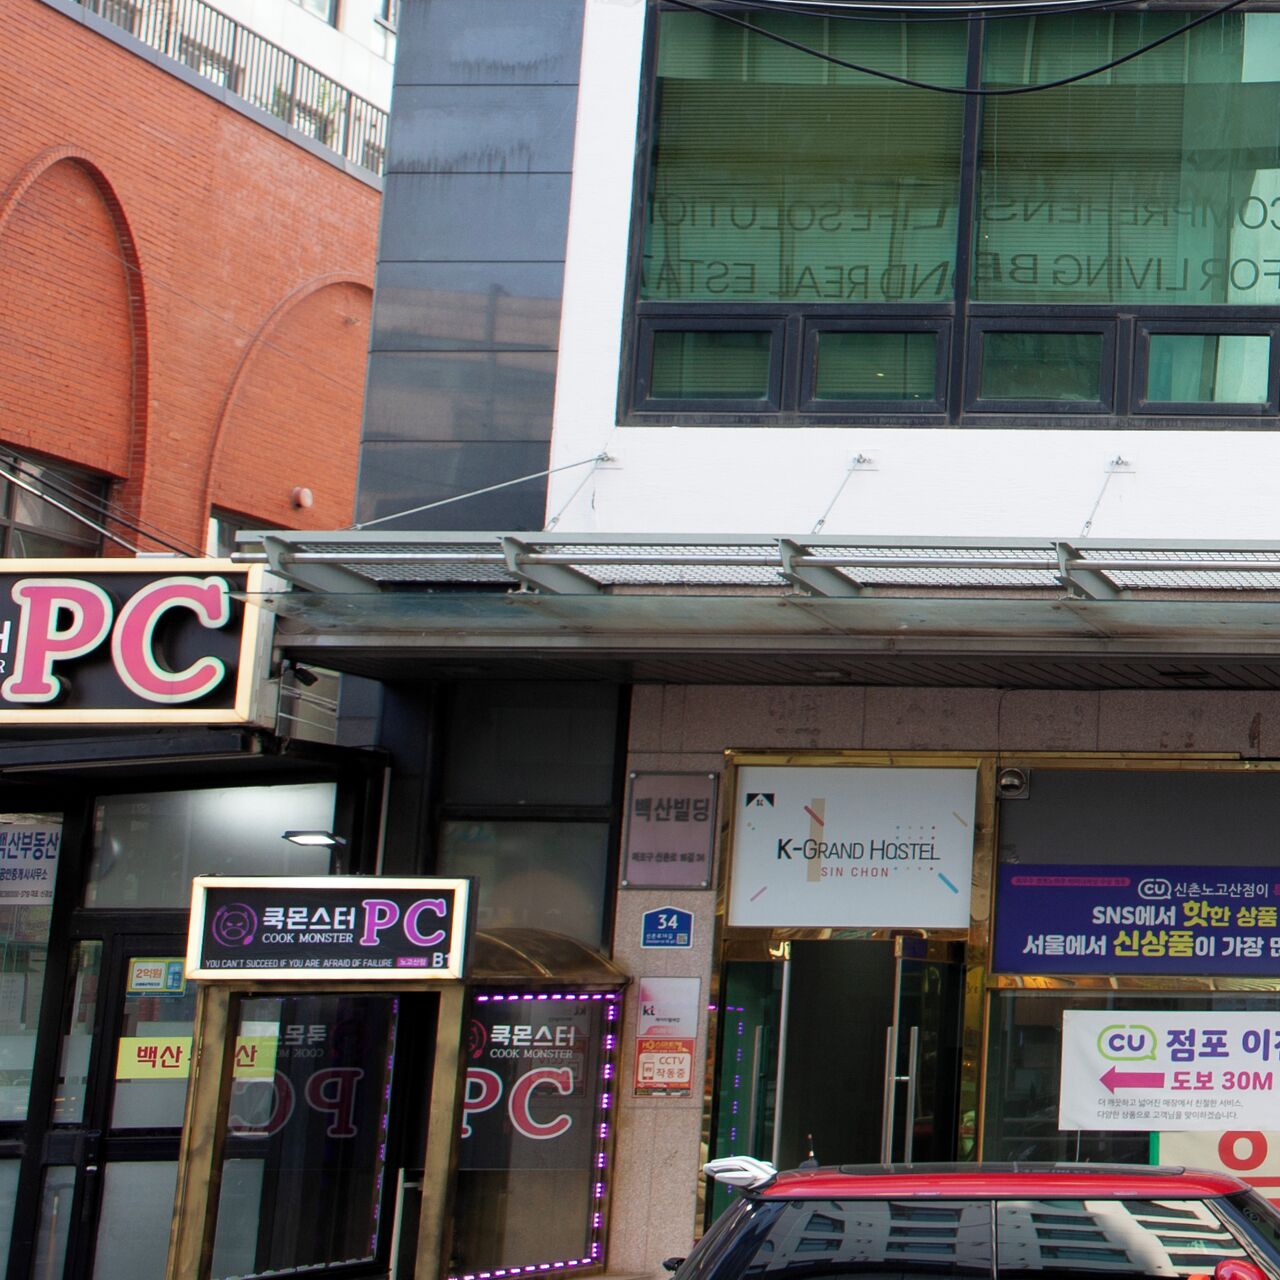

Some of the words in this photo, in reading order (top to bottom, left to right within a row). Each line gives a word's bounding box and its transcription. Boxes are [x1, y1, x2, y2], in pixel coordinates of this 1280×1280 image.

[1, 576, 230, 704] PC
[634, 797, 710, 823] 백산빌딩
[820, 866, 844, 878] SIN
[850, 866, 889, 878] CHON
[1174, 882, 1269, 898] 신촌노고산점이
[262, 906, 356, 930] 쿡몬스터
[360, 898, 447, 947] PC
[657, 913, 679, 930] 34
[1091, 905, 1177, 926] SNS에서
[1182, 900, 1231, 927] 핫한
[1236, 906, 1278, 928] 상품
[261, 932, 295, 944] COOK
[298, 932, 354, 944] MONSTER
[1022, 934, 1107, 956] 서울에서
[1112, 929, 1215, 957] 신상품이
[1221, 936, 1265, 957] 가장
[205, 958, 220, 968] YOU
[289, 958, 302, 968] YOU
[305, 958, 320, 968] ARE
[490, 1024, 576, 1047] 쿡몬스터
[1166, 1028, 1231, 1062] 점포
[489, 1048, 520, 1059] COOK
[523, 1048, 574, 1059] MONSTER
[659, 1056, 685, 1065] CCTV
[656, 1068, 686, 1079] 작동중
[1170, 1070, 1213, 1091] 도보
[1221, 1070, 1274, 1091] 30M
[461, 1067, 574, 1140] PC
